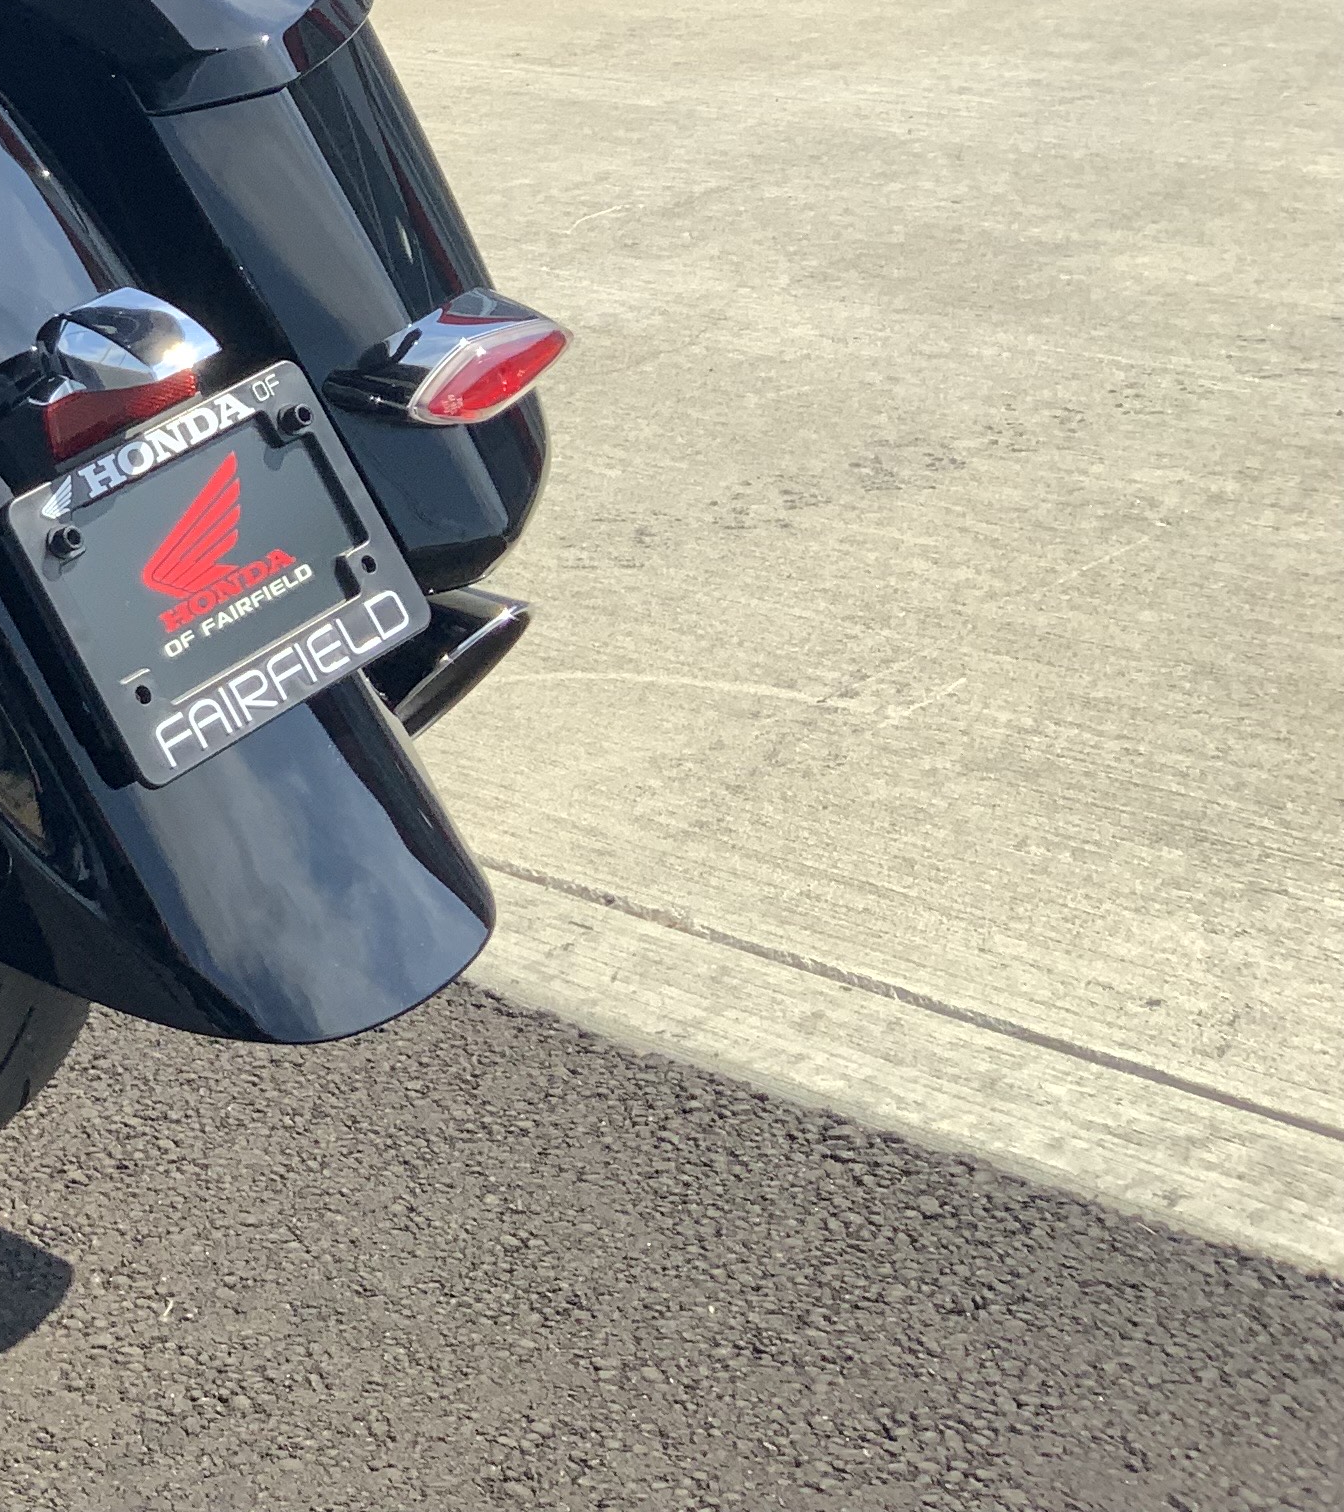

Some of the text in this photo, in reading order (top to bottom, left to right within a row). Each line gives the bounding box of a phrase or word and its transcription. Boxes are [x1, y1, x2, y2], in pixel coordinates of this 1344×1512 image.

[78, 375, 280, 498] HONDA OF
[158, 548, 297, 632] HONDA
[163, 563, 314, 658] OF FAIRFIELD
[154, 590, 411, 768] FAIRFIELD
